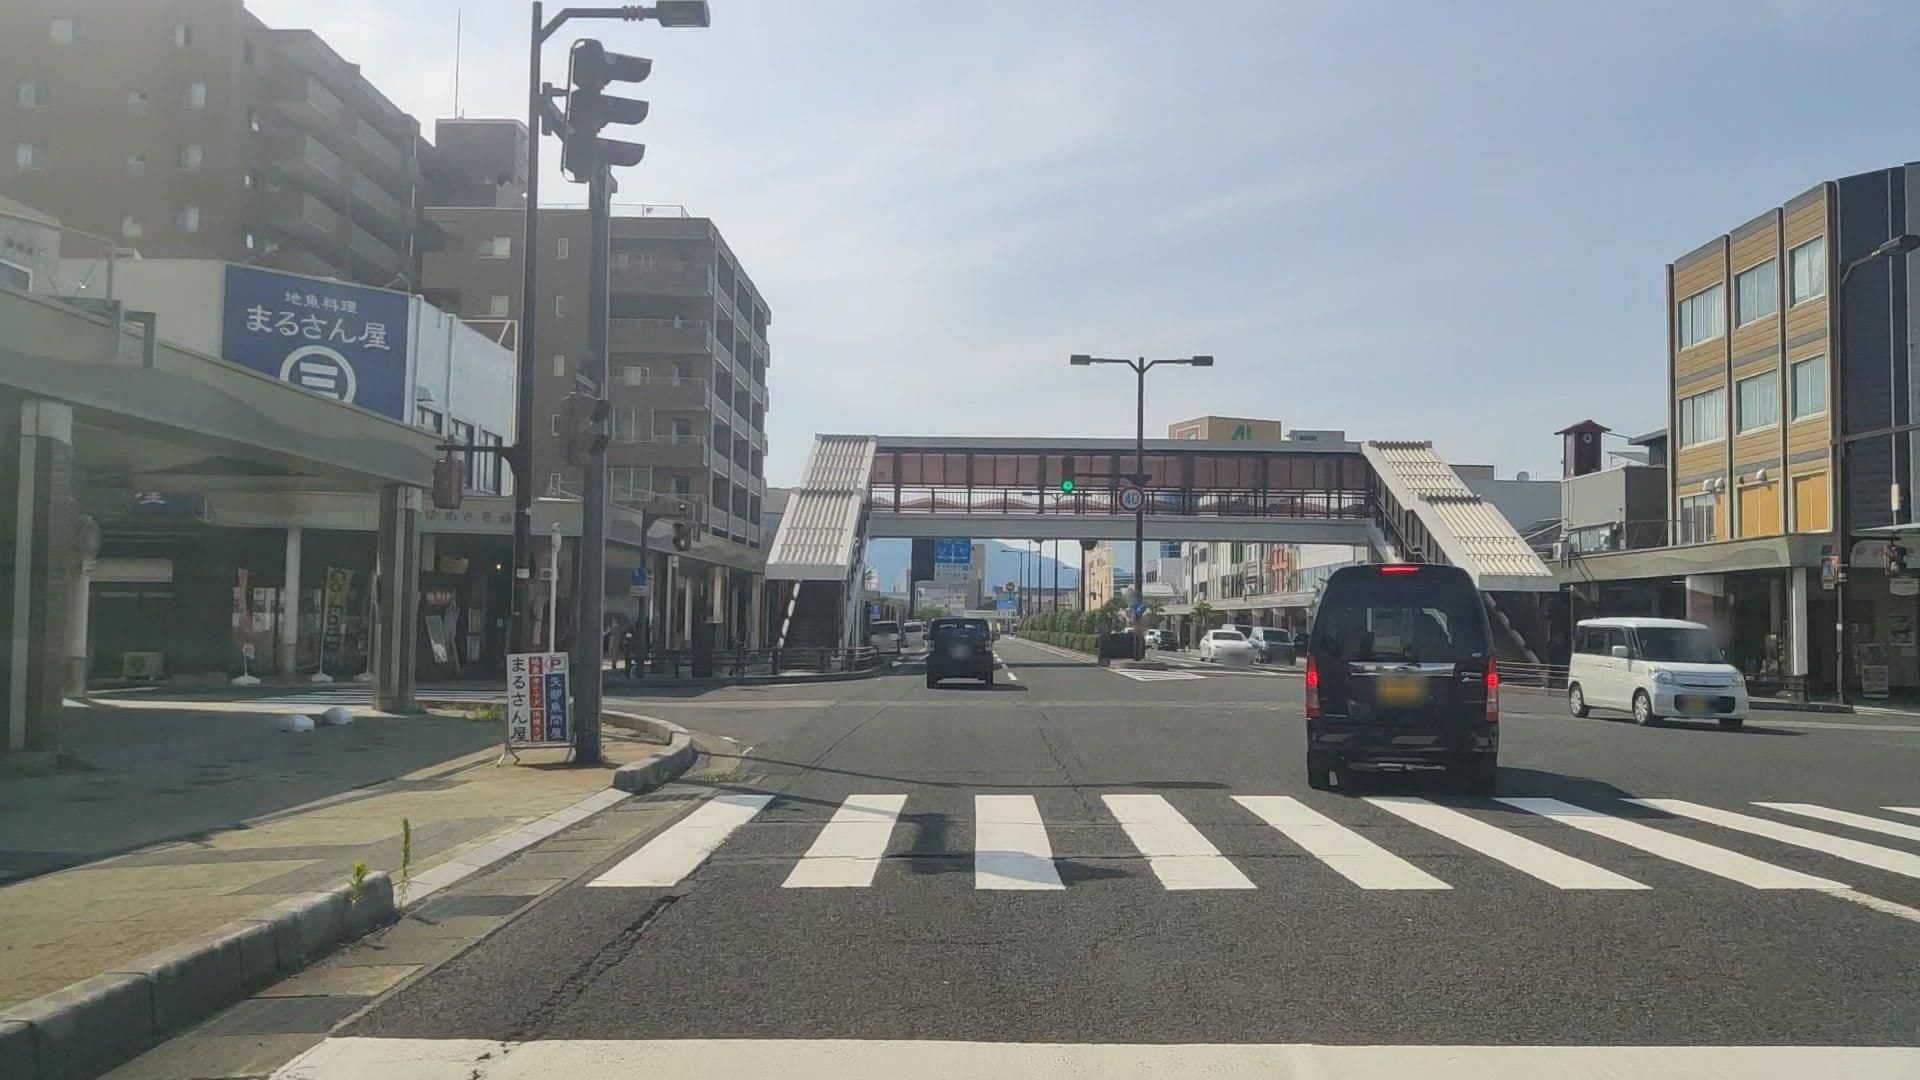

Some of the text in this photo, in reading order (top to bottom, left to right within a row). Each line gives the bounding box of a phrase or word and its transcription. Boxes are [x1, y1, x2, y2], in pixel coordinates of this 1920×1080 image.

[284, 290, 358, 313] 地魚料理
[246, 304, 391, 351] まるさん屋
[1124, 492, 1140, 505] 40
[550, 659, 561, 668] P
[511, 657, 529, 743] まるさん屋
